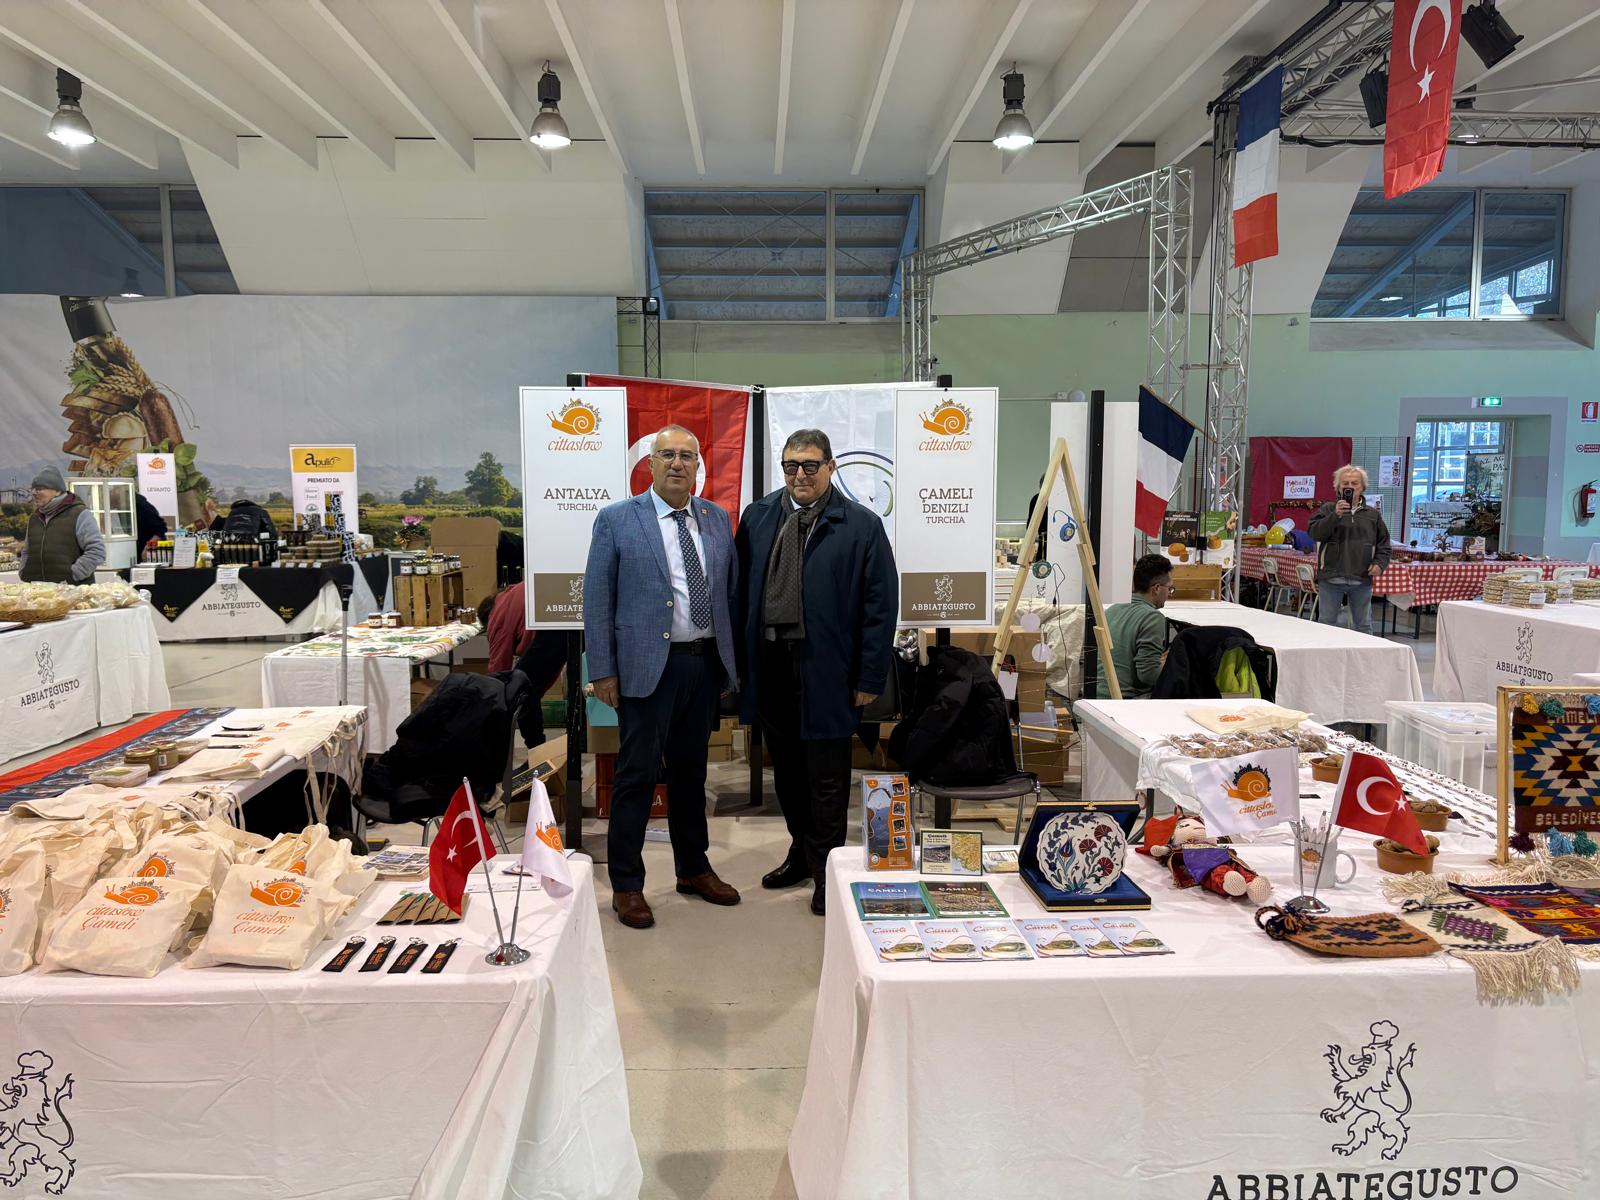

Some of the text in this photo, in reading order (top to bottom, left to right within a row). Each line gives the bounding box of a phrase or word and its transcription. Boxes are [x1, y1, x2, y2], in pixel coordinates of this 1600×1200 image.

[548, 436, 603, 452] cittaslow
[918, 436, 973, 452] cittaslow
[543, 488, 612, 500] ANTALYA
[918, 487, 974, 504] ÇAMELI
[556, 503, 598, 512] TURCHIA
[922, 503, 969, 514] DENIZLI
[925, 516, 966, 524] TURCHIA
[201, 601, 262, 612] ABBIATEGUSTO
[545, 604, 584, 612] ABBIATE
[911, 602, 976, 612] ABBIATEGUSTO
[1496, 660, 1554, 683] ABBIATEGUSTO
[20, 678, 80, 708] ABBIATEGUSTO
[1207, 1165, 1519, 1200] ABBIATEGUSTO
